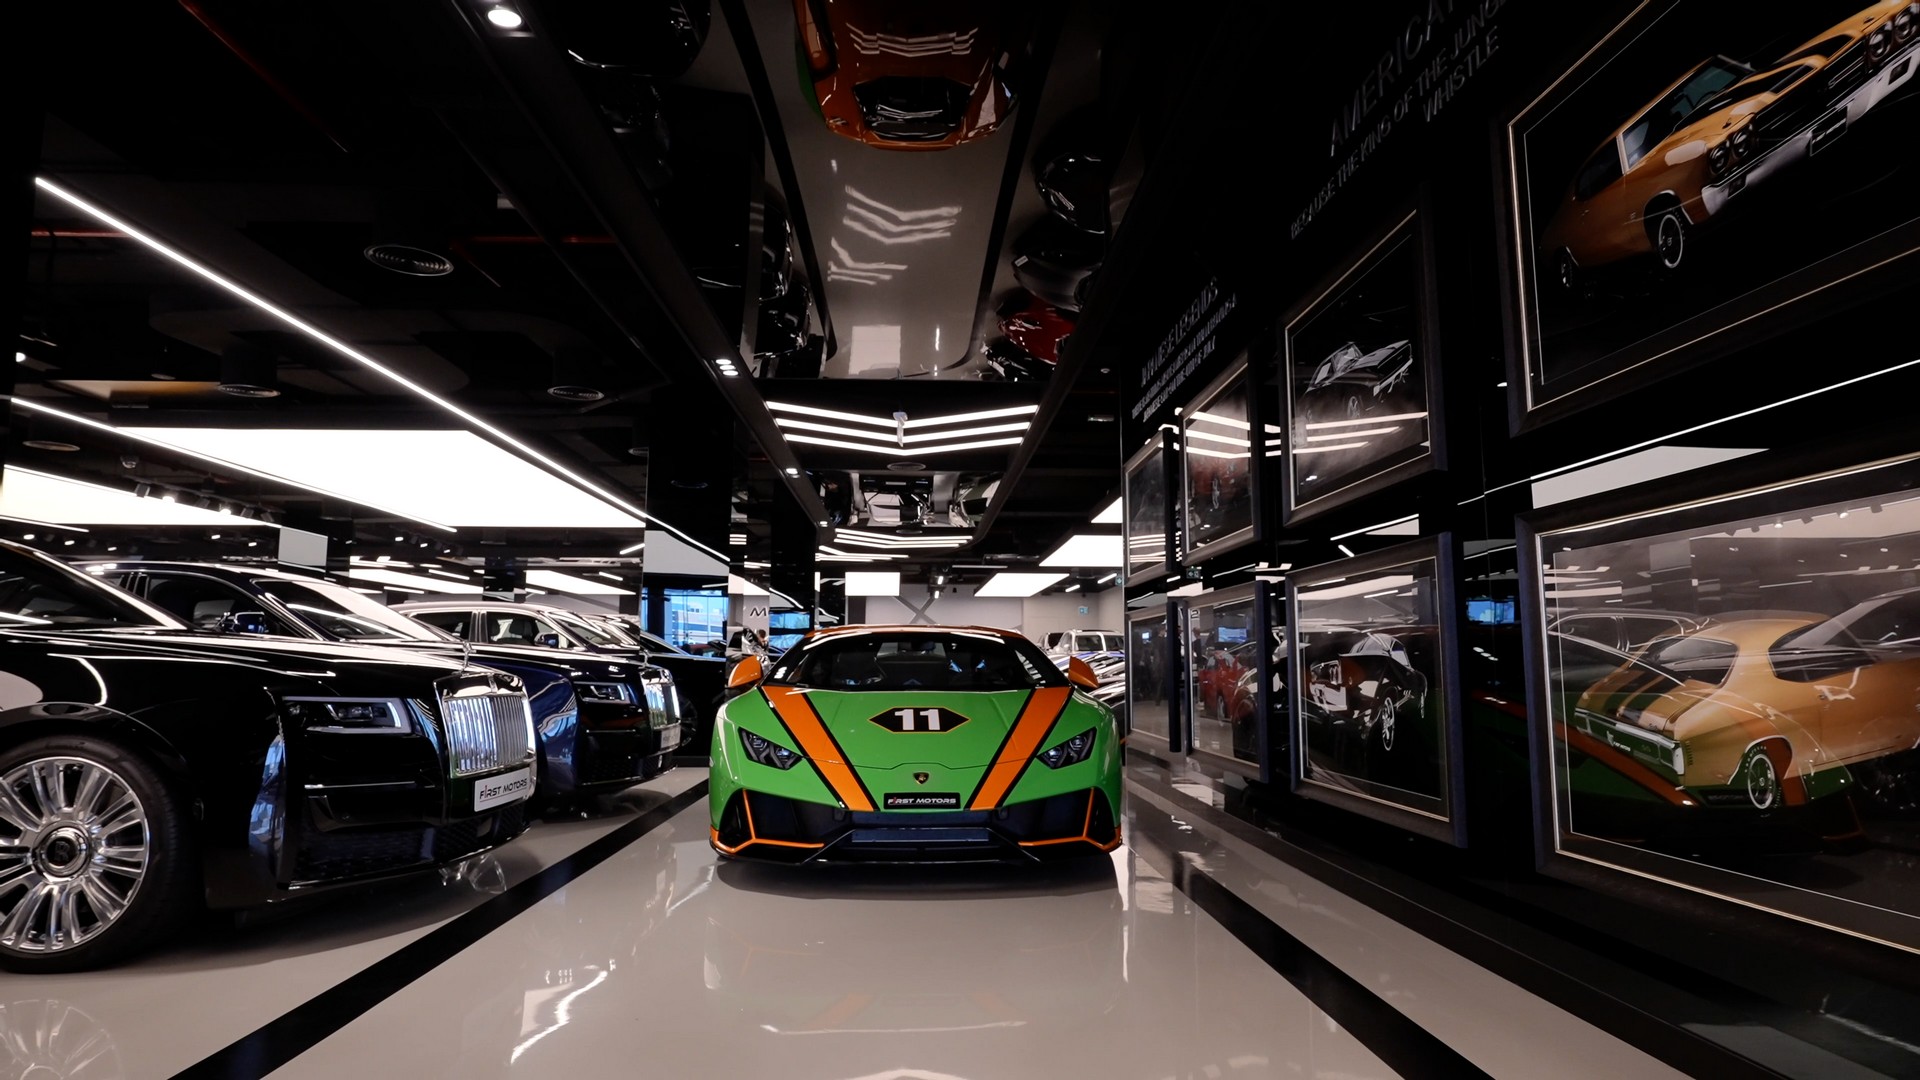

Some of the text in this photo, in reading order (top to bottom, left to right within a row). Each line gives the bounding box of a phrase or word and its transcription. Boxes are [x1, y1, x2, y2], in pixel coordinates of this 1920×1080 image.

[1423, 25, 1500, 123] WHISTLE
[1289, 176, 1336, 241] BECAUSE
[1335, 149, 1360, 188] THE
[1360, 114, 1393, 162] KING
[1393, 86, 1414, 123] OF
[1416, 47, 1448, 97] THE
[894, 708, 941, 731] 11
[502, 778, 527, 793] MOTORS
